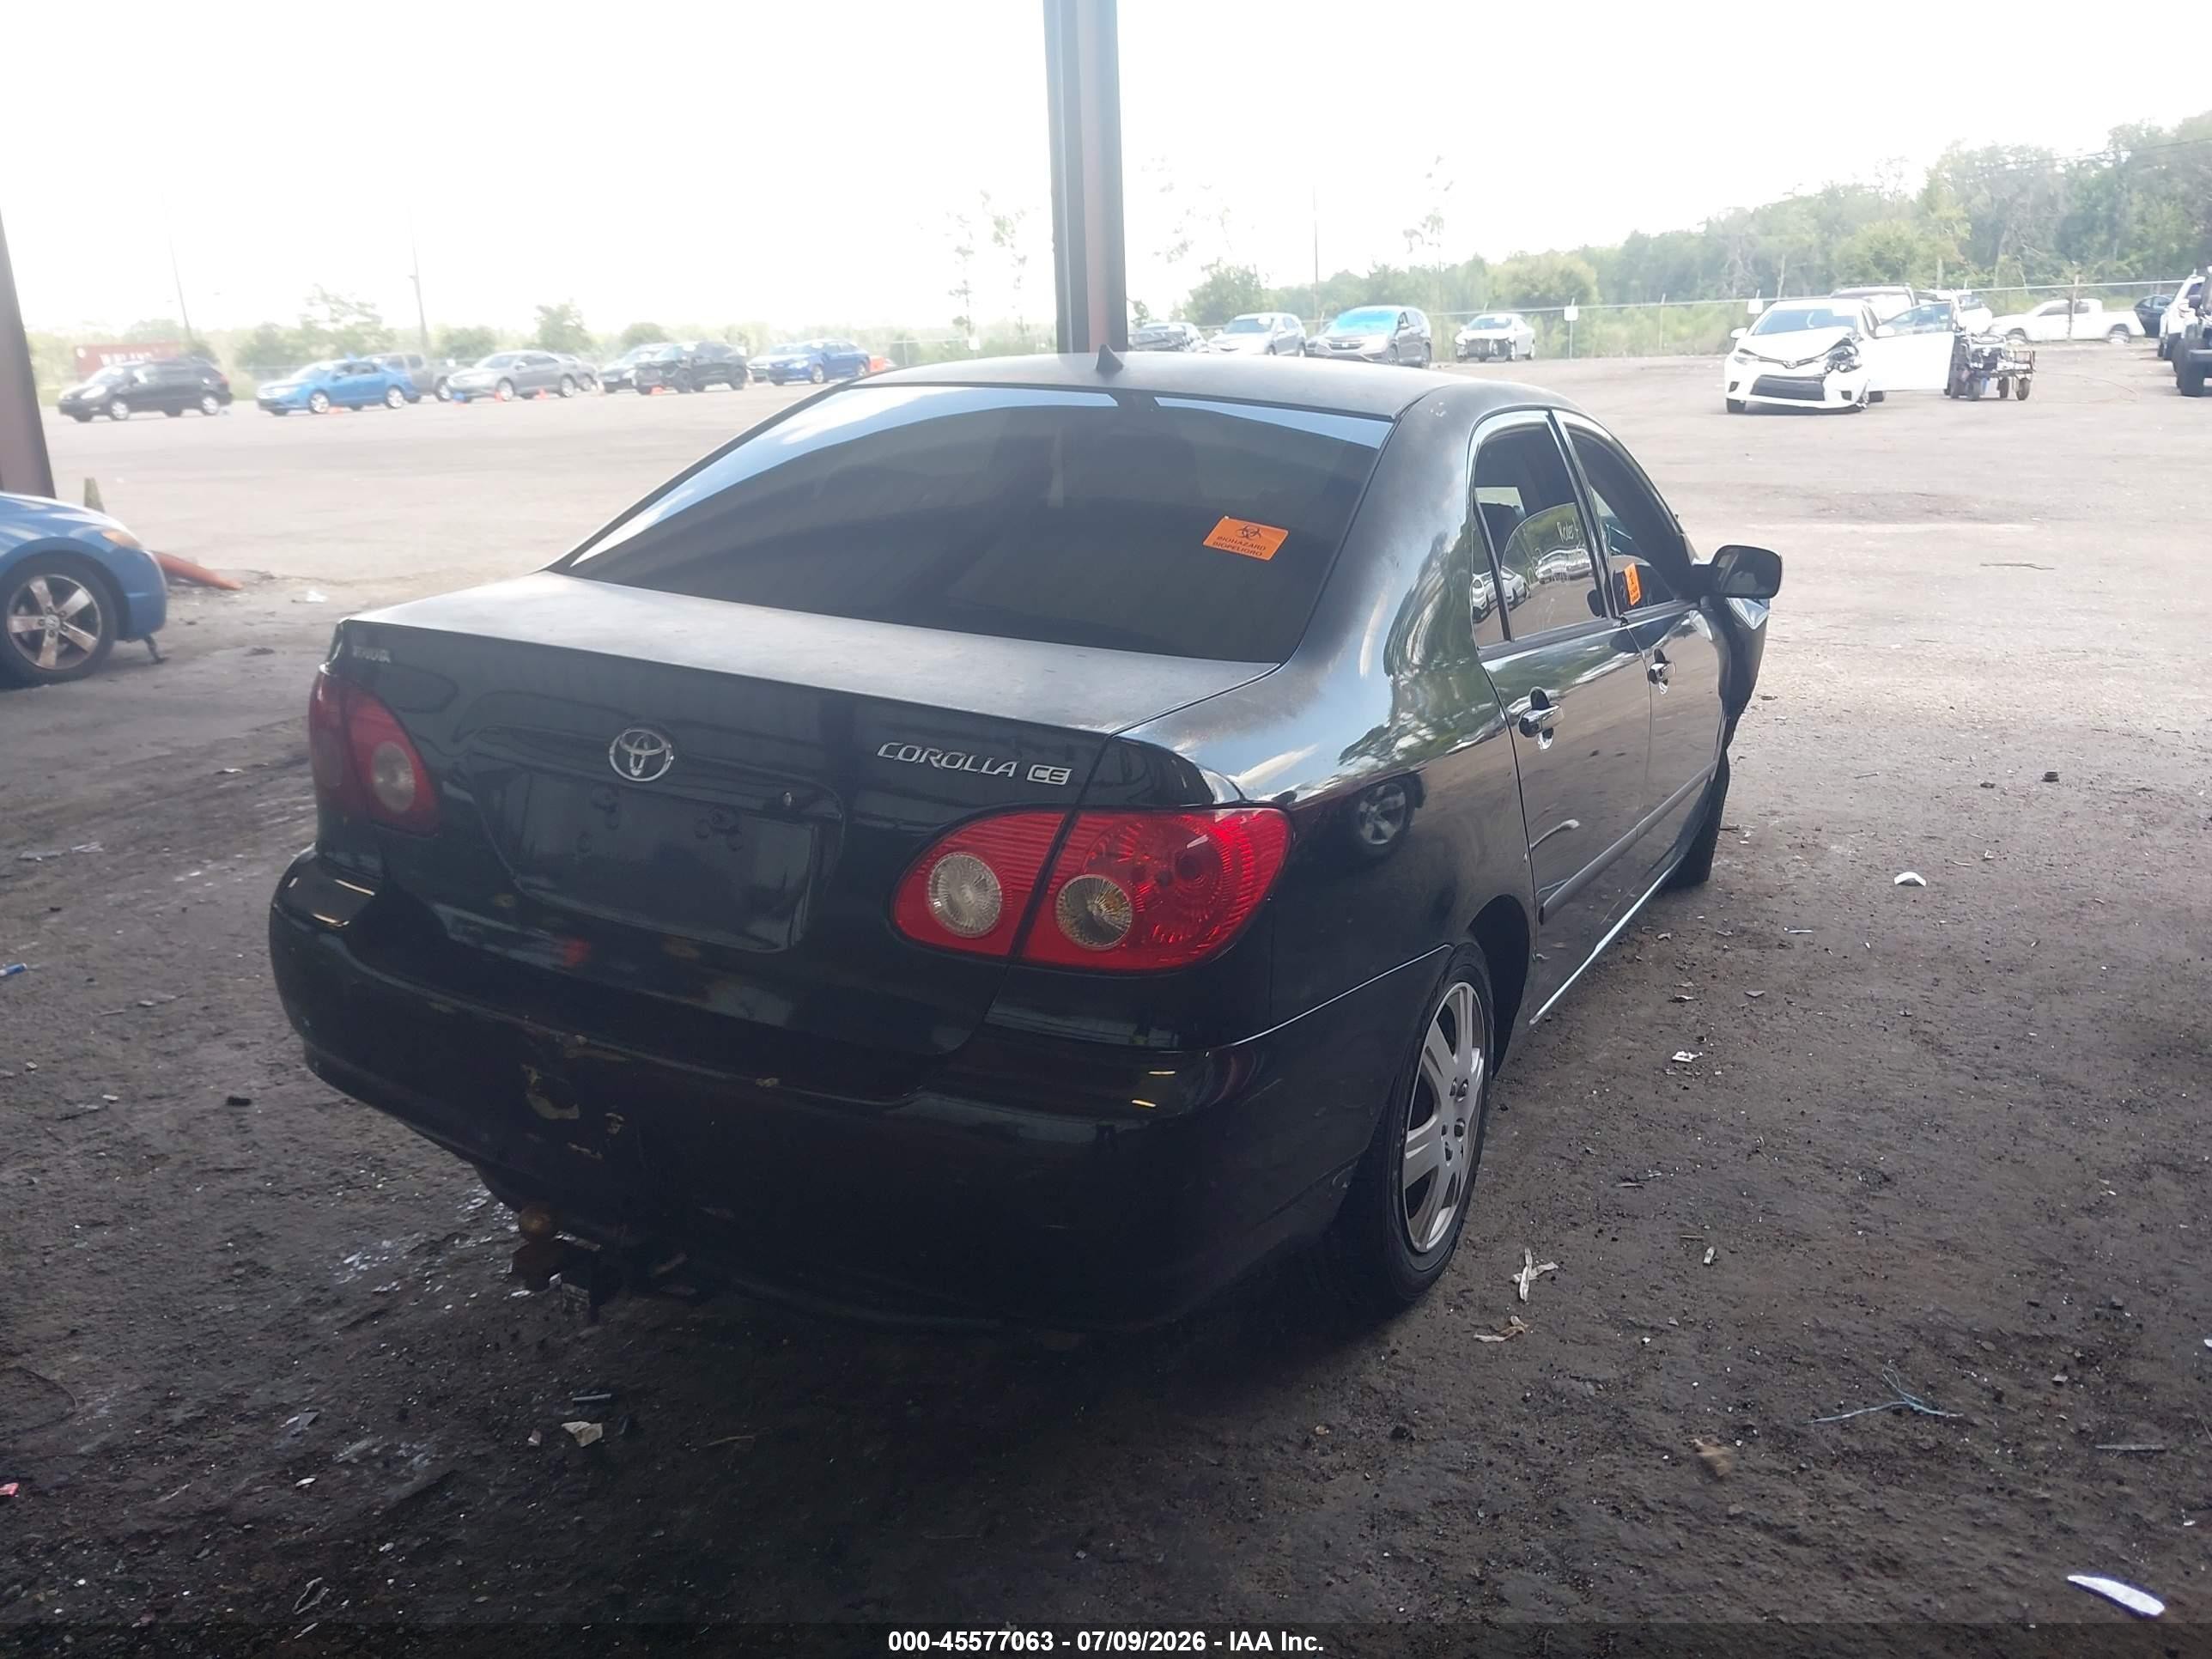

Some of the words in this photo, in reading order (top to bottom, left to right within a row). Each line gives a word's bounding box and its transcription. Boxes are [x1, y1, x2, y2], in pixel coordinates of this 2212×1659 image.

[1216, 536, 1267, 551] BIOHAZARD
[877, 742, 1020, 777] COROLLA
[1030, 765, 1070, 784] CE
